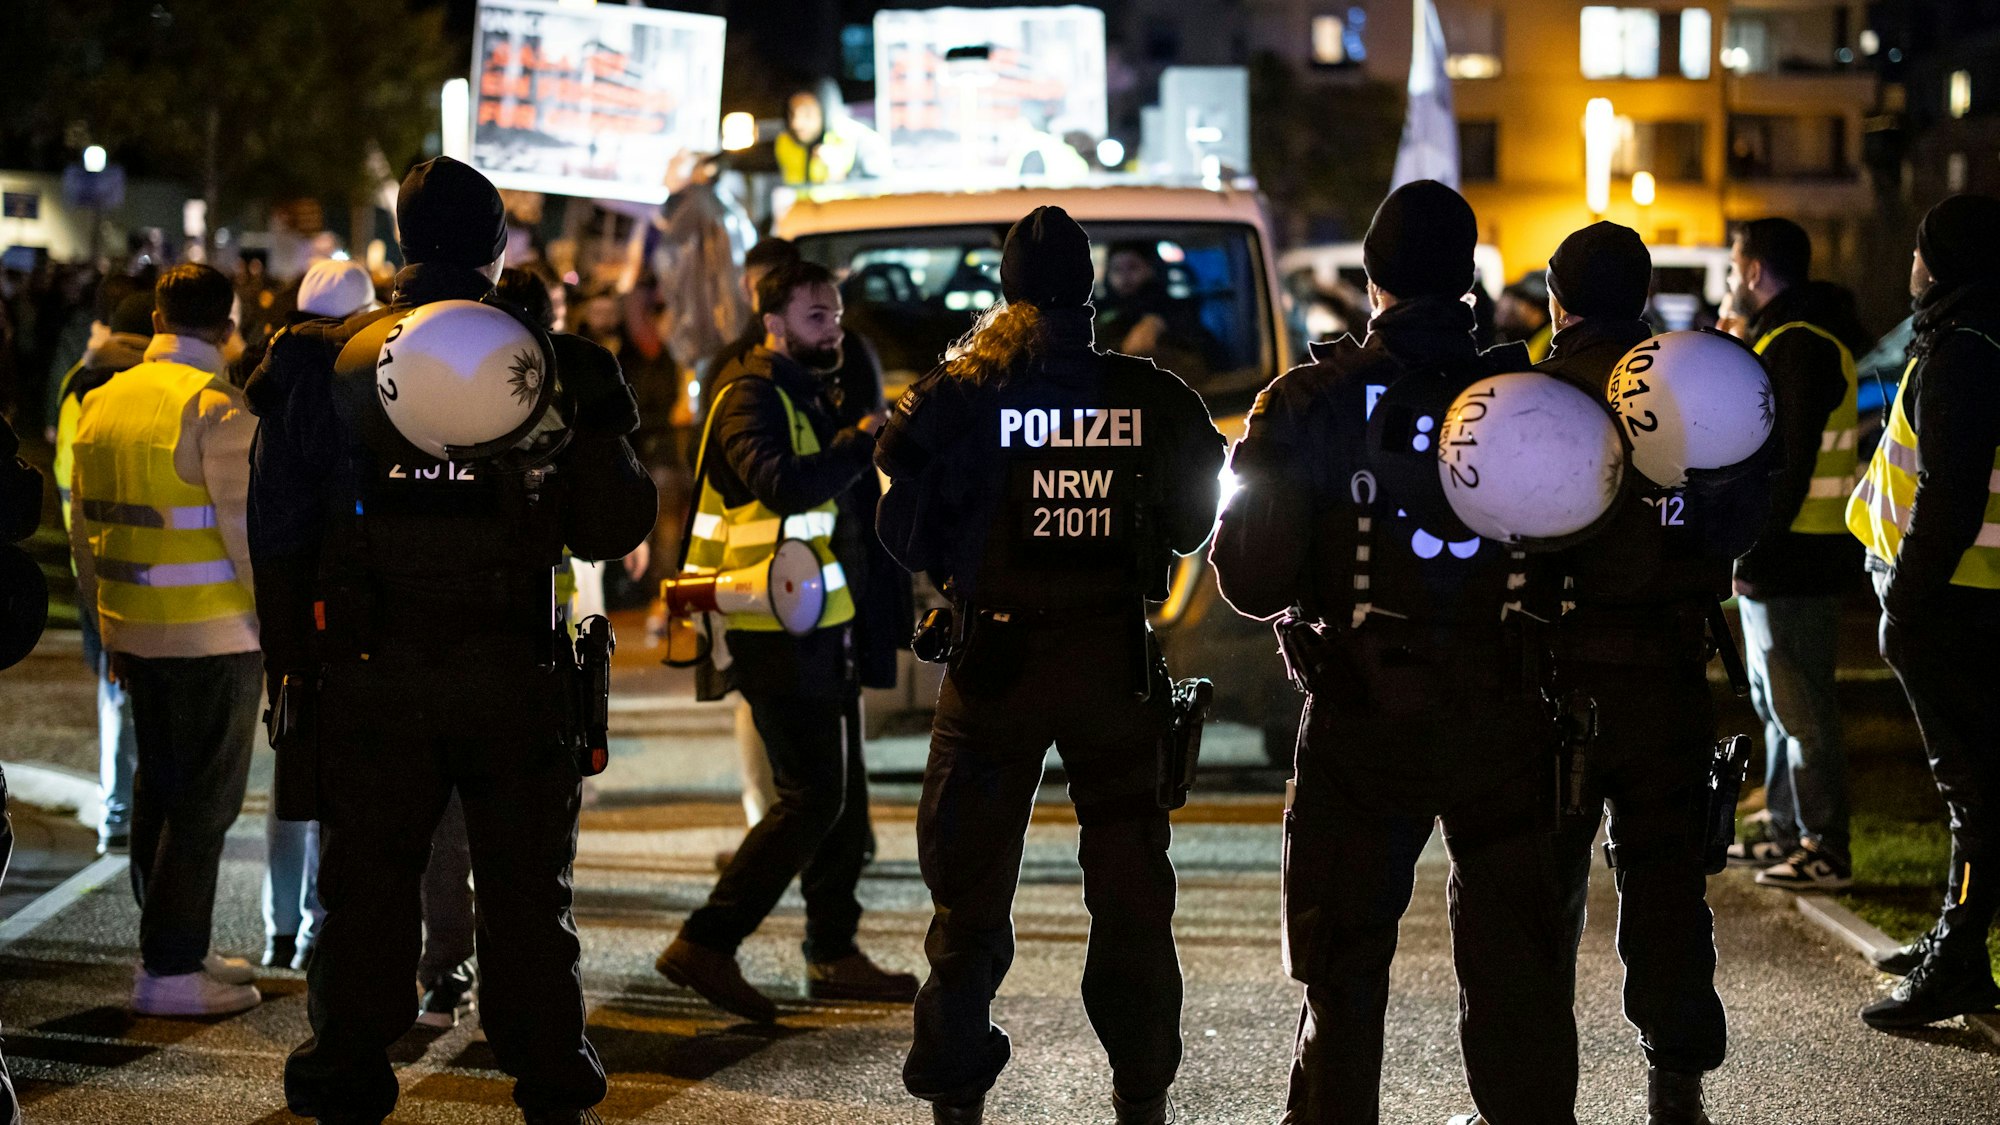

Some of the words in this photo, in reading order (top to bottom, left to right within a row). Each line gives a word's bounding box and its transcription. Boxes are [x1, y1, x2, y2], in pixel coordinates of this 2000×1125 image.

[1622, 341, 1661, 437] 10-1-2
[1000, 408, 1142, 447] POLIZEI
[1450, 387, 1496, 489] 10-1-2
[1032, 469, 1113, 498] NRW
[1033, 507, 1111, 537] 21011
